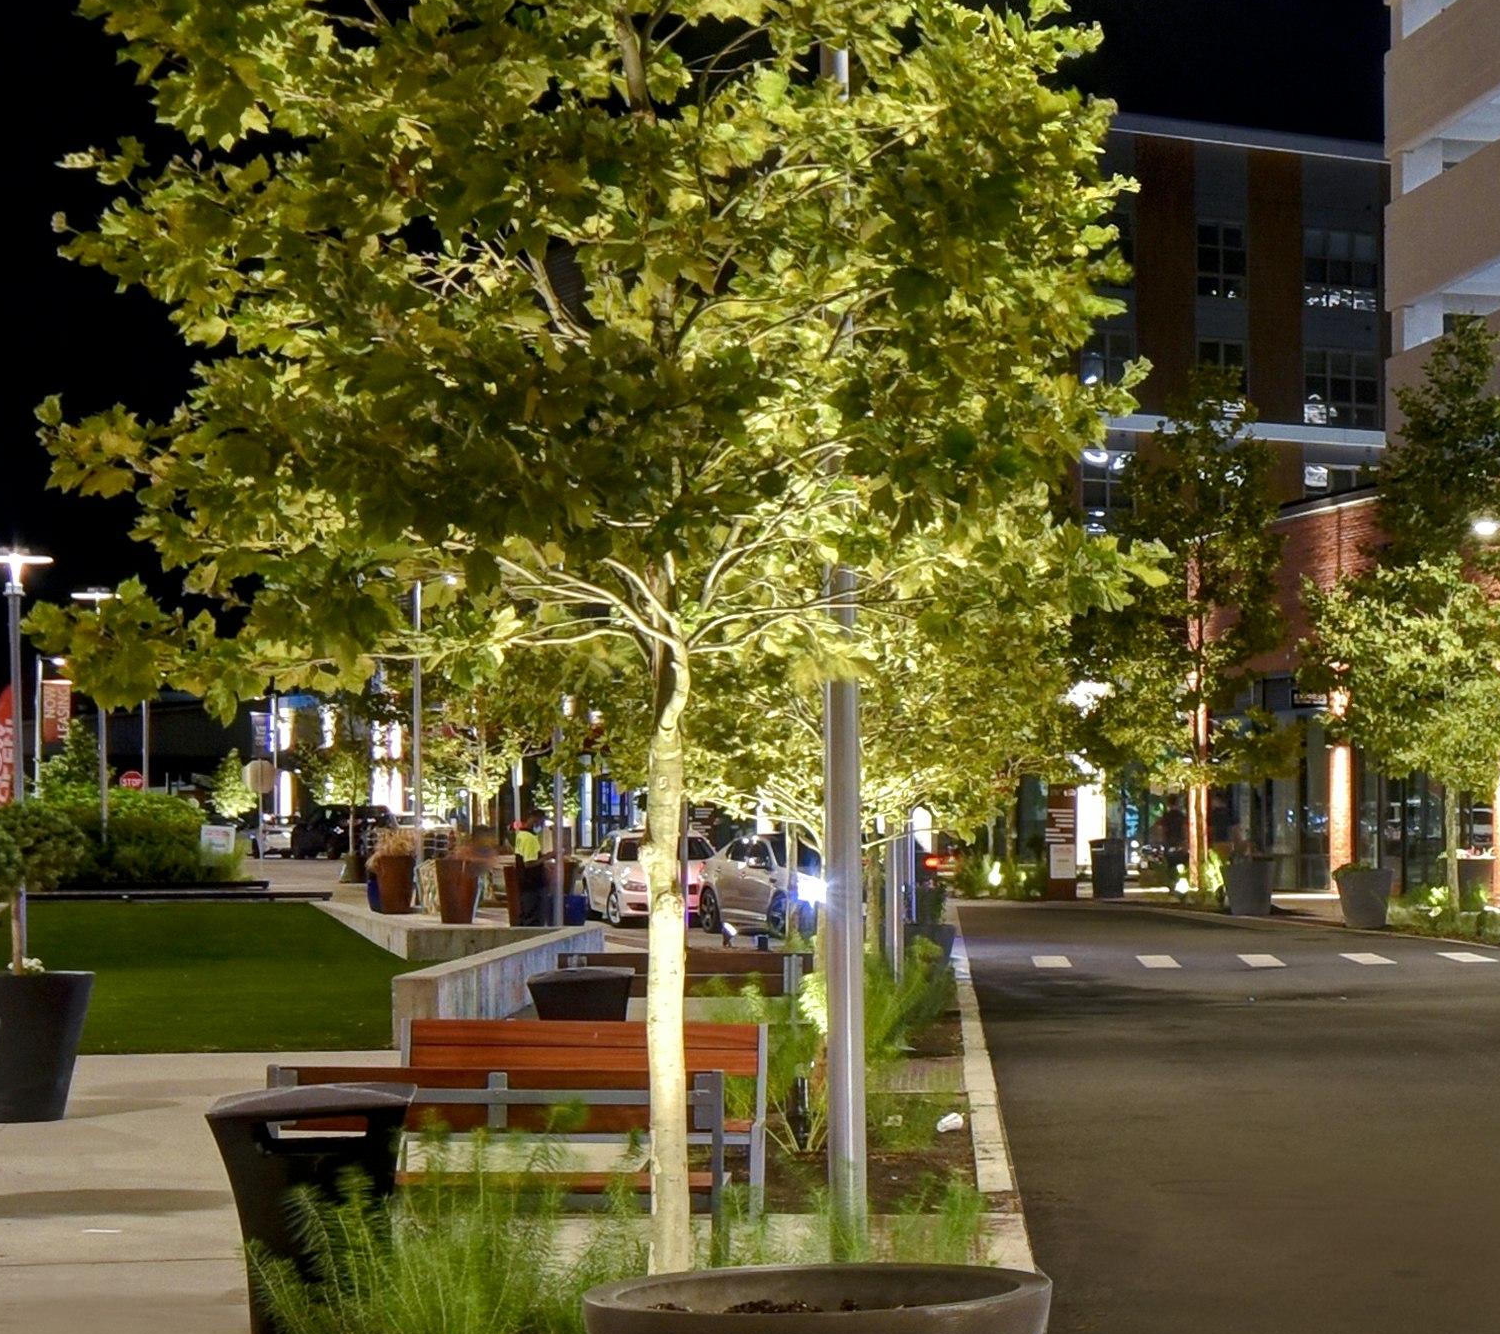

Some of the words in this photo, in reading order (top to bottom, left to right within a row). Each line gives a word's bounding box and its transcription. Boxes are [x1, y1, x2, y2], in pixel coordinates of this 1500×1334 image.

[44, 685, 56, 719] NOW
[57, 685, 70, 739] LEASING
[122, 778, 142, 787] STOP
